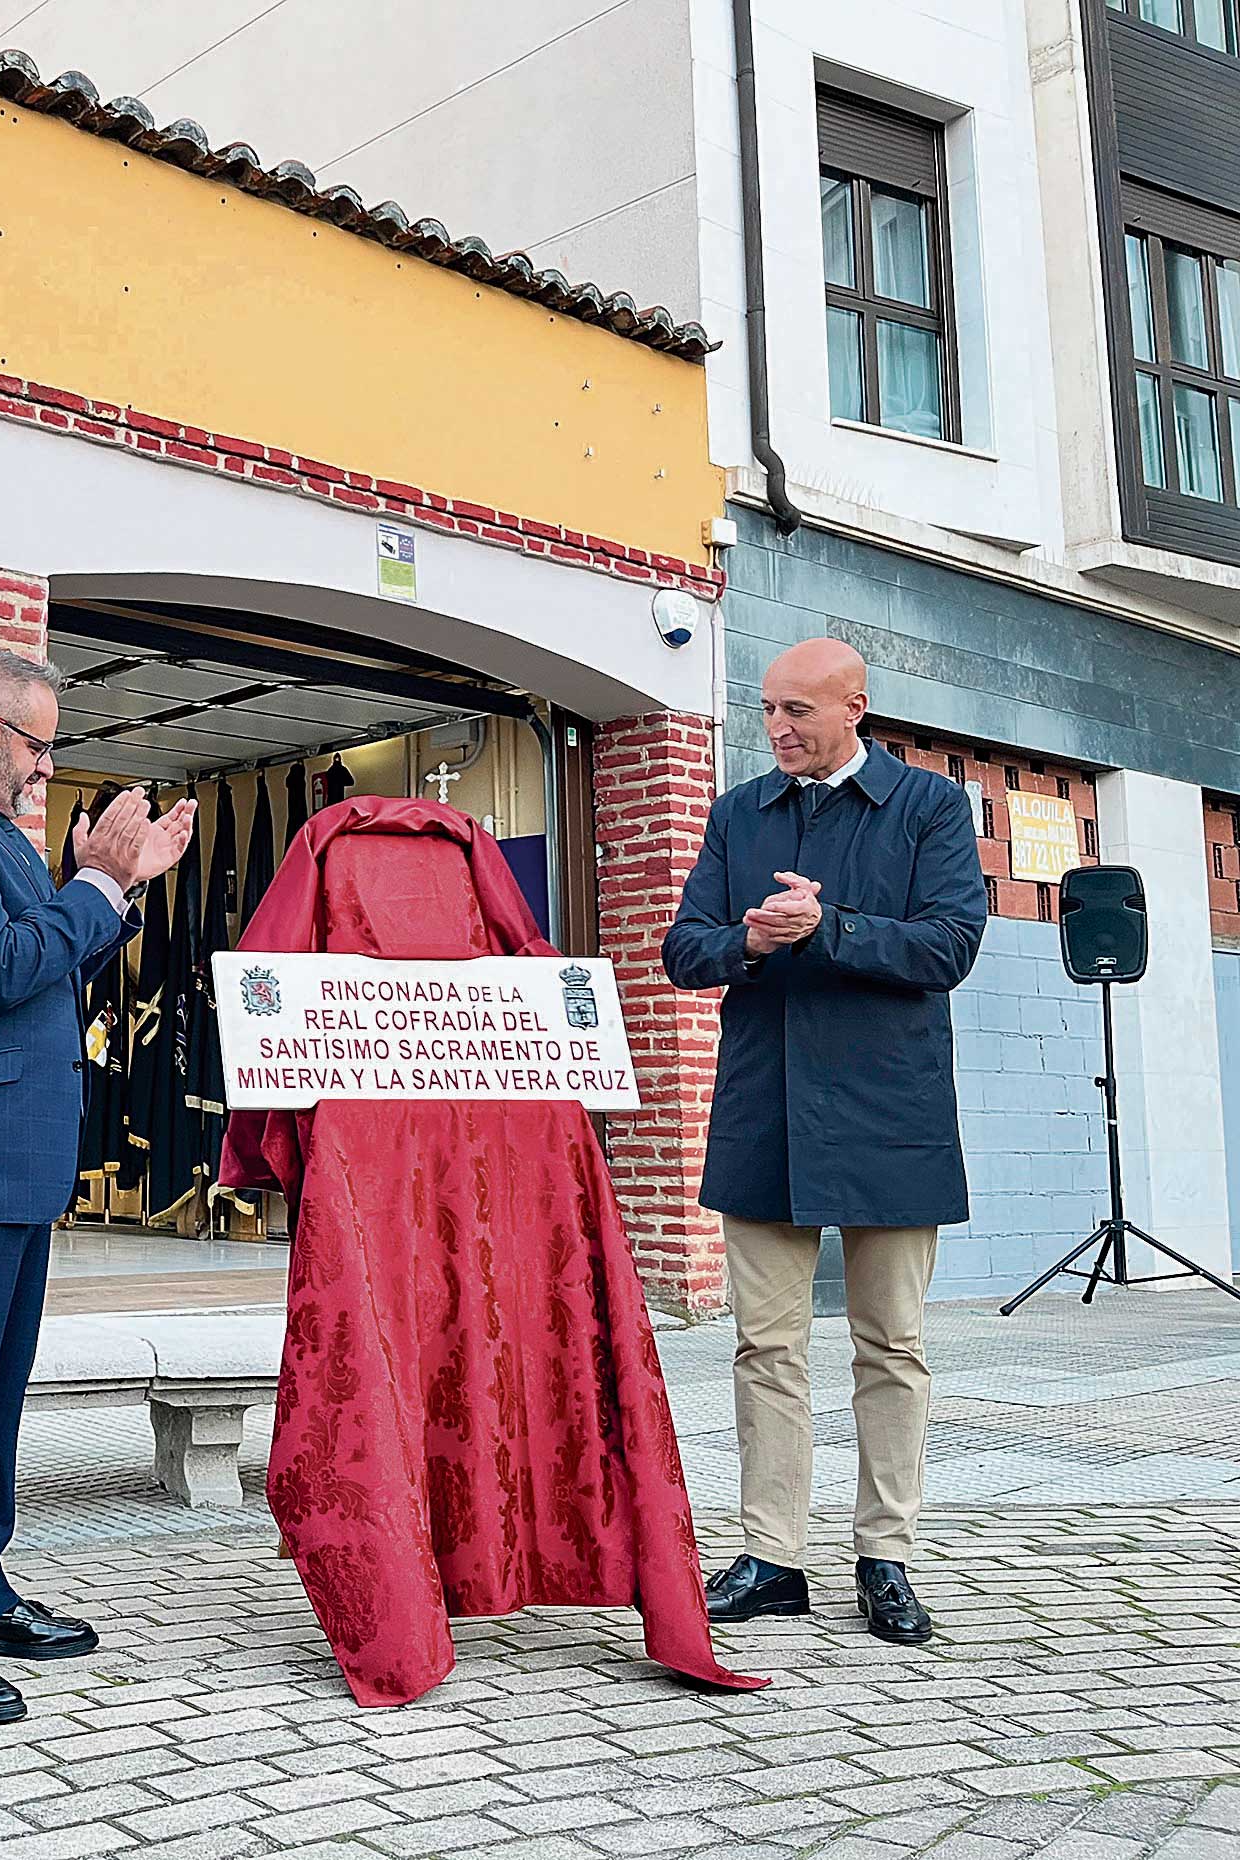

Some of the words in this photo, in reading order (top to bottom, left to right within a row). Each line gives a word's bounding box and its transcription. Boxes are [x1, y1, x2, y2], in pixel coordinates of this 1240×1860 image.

[1012, 796, 1073, 823] ALQUILA
[320, 980, 462, 1003] RINCONADA
[467, 986, 494, 1003] DE
[498, 986, 524, 1003] LA
[303, 1009, 368, 1030] REAL
[375, 1004, 497, 1032] COFRADÍA
[502, 1011, 549, 1032] DEL
[259, 1032, 390, 1060] SANTÍSIMO
[398, 1039, 562, 1061] SACRAMENTO
[569, 1039, 601, 1062] DE
[237, 1067, 346, 1090] MINERVA
[349, 1068, 365, 1090] Y
[373, 1068, 406, 1090] LA
[411, 1068, 491, 1091] SANTA
[494, 1068, 561, 1091] VERA
[566, 1069, 630, 1091] CRUZ
